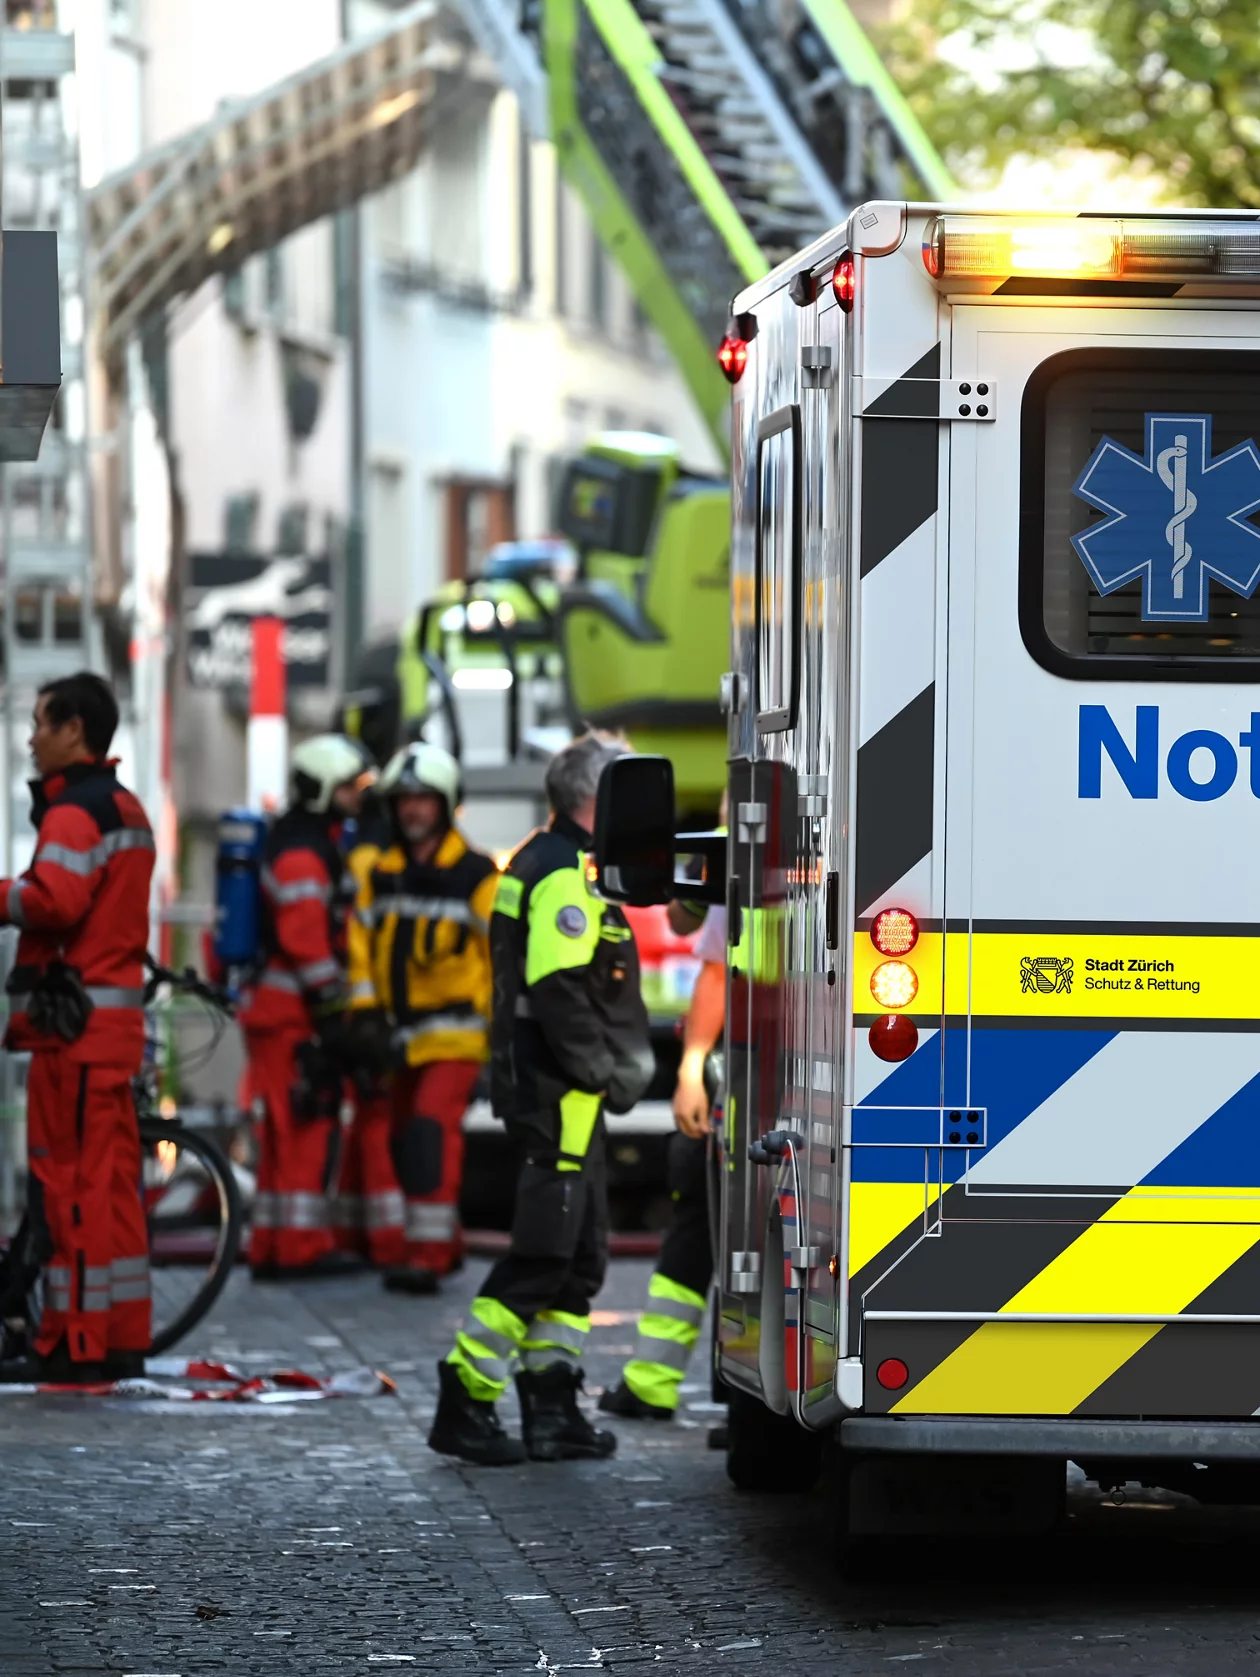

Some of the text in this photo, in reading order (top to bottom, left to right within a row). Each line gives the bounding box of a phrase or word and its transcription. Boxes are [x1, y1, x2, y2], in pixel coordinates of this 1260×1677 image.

[1084, 958, 1175, 973] Stadt Zürich
[1084, 977, 1201, 994] Schutz & Rettung
